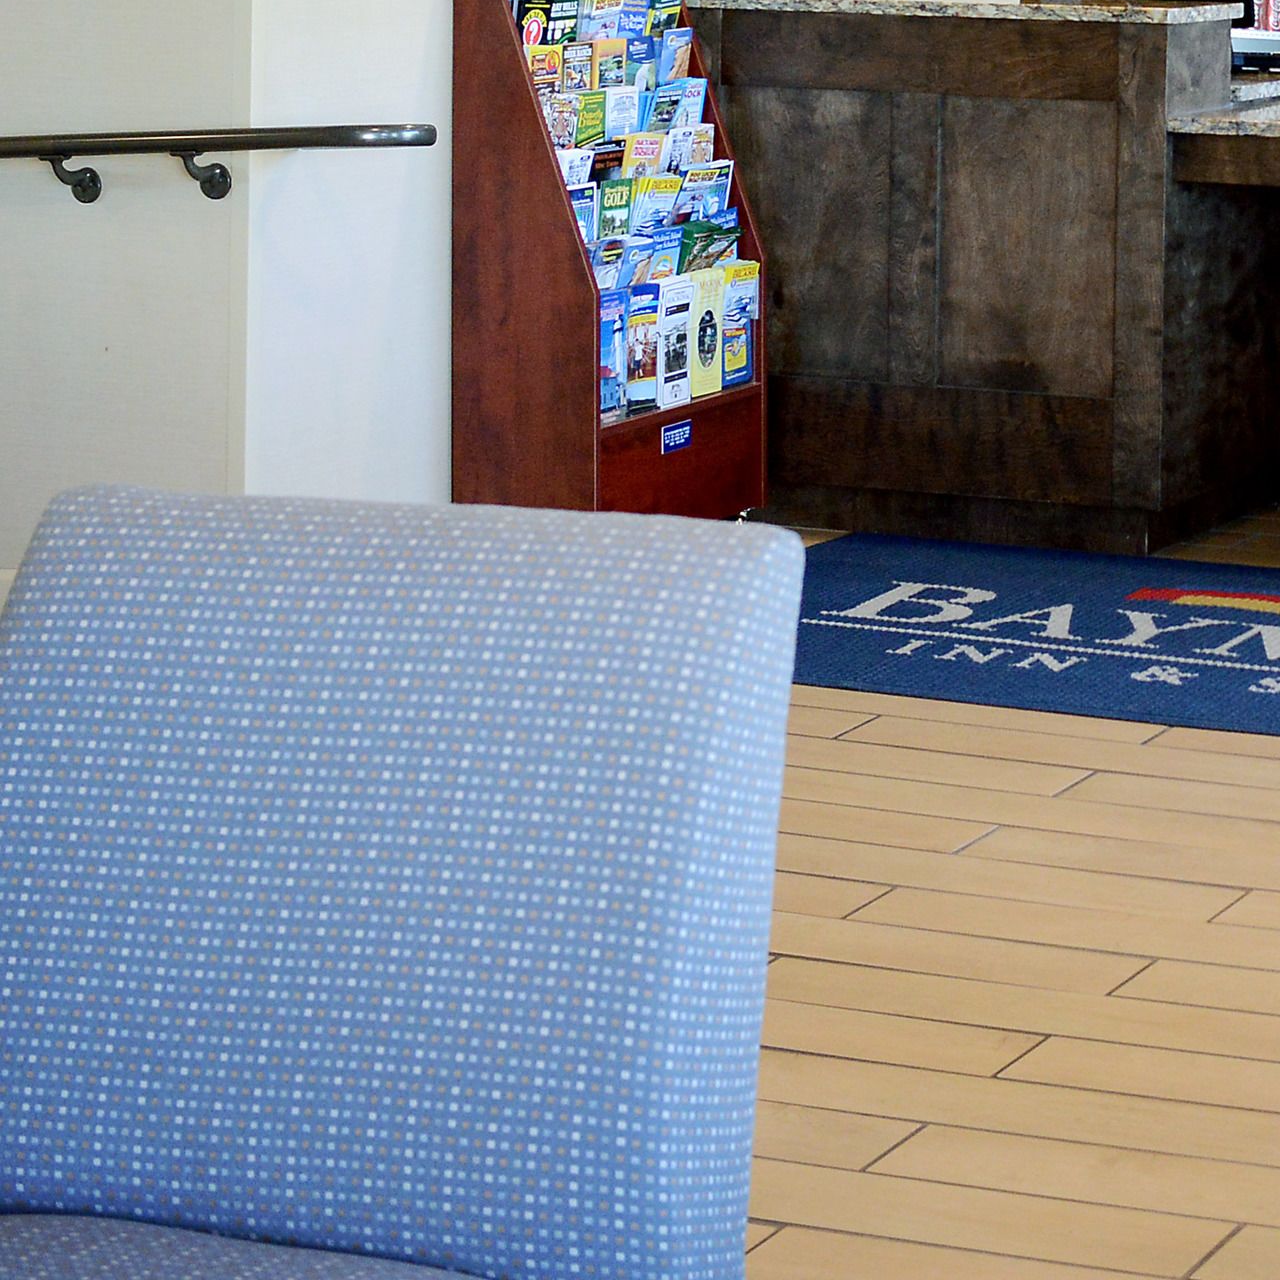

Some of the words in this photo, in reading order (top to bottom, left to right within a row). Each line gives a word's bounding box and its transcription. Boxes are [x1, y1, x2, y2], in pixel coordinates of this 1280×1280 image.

[604, 192, 629, 207] GOLF
[885, 638, 1088, 674] INN
[1130, 665, 1199, 687] &
